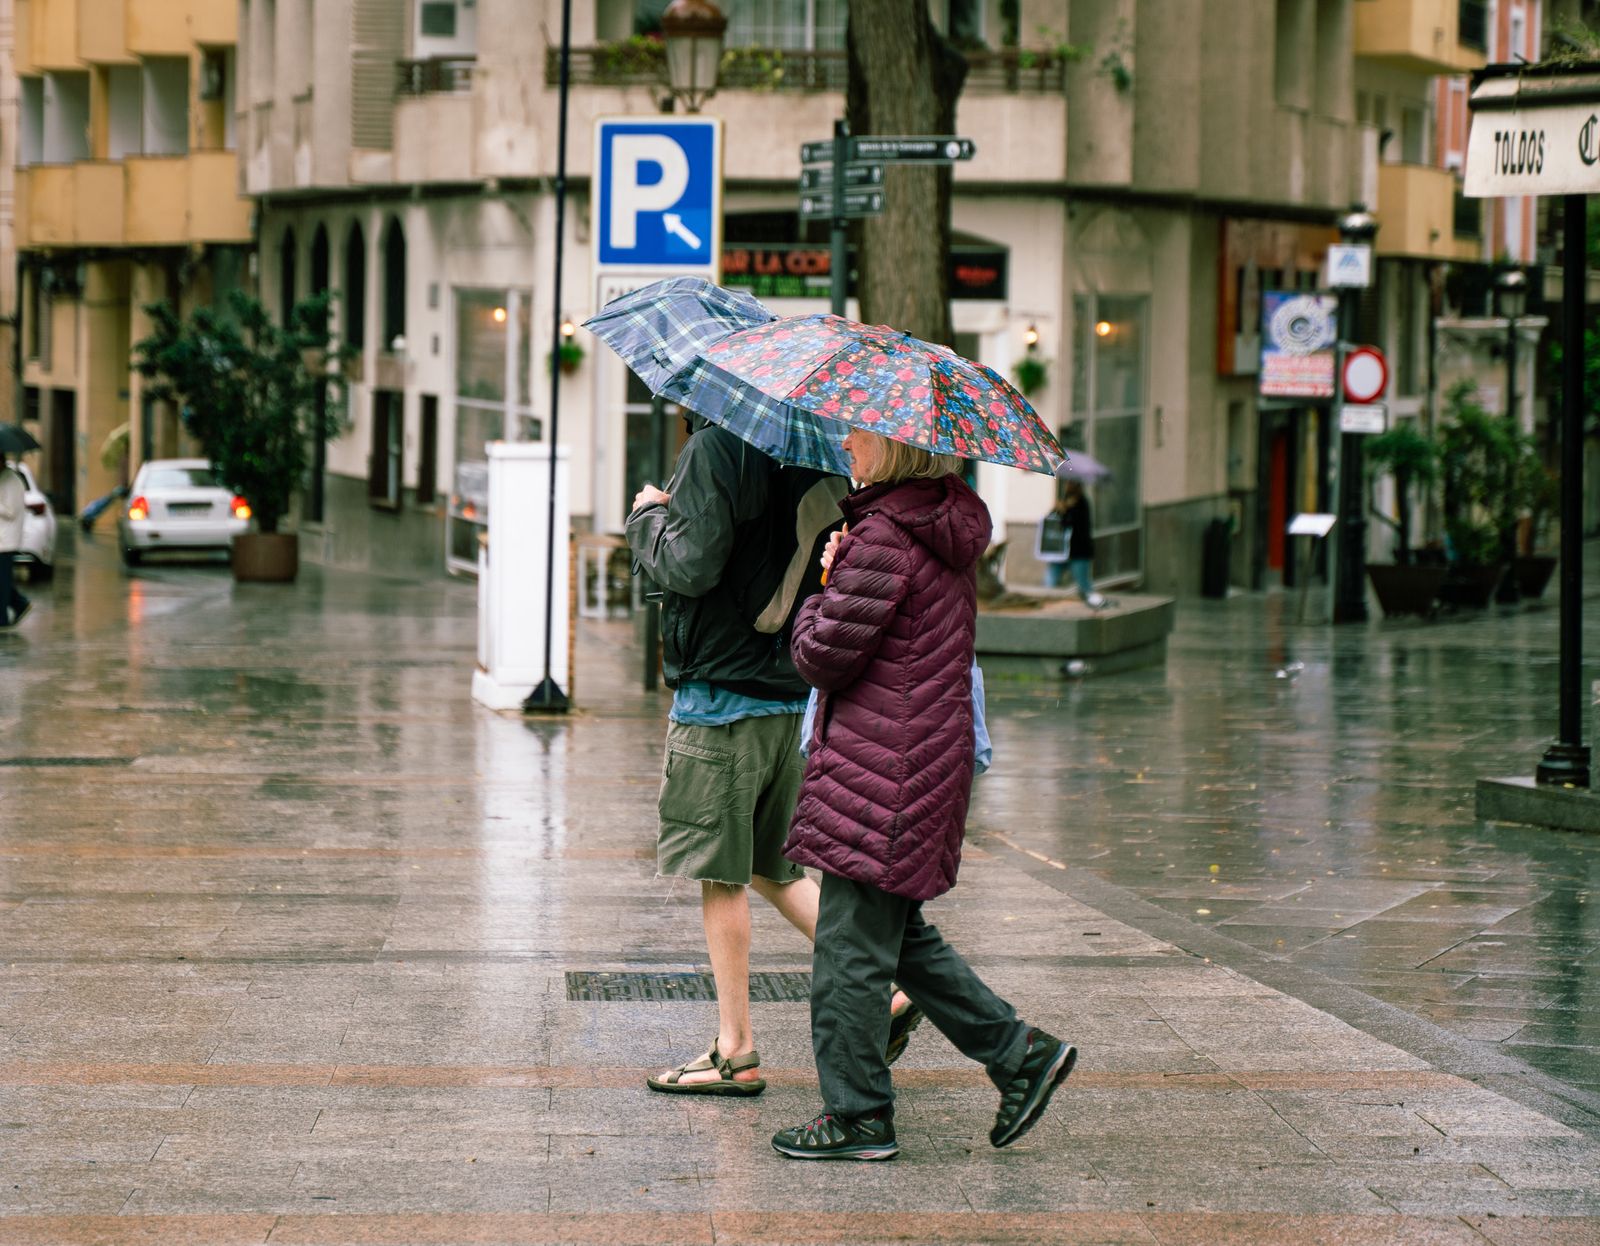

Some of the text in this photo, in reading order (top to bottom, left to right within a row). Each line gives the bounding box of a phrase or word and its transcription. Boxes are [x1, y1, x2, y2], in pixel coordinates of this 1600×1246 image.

[1494, 113, 1600, 175] TOLDOS C
[610, 133, 690, 249] P
[752, 250, 783, 273] LA
